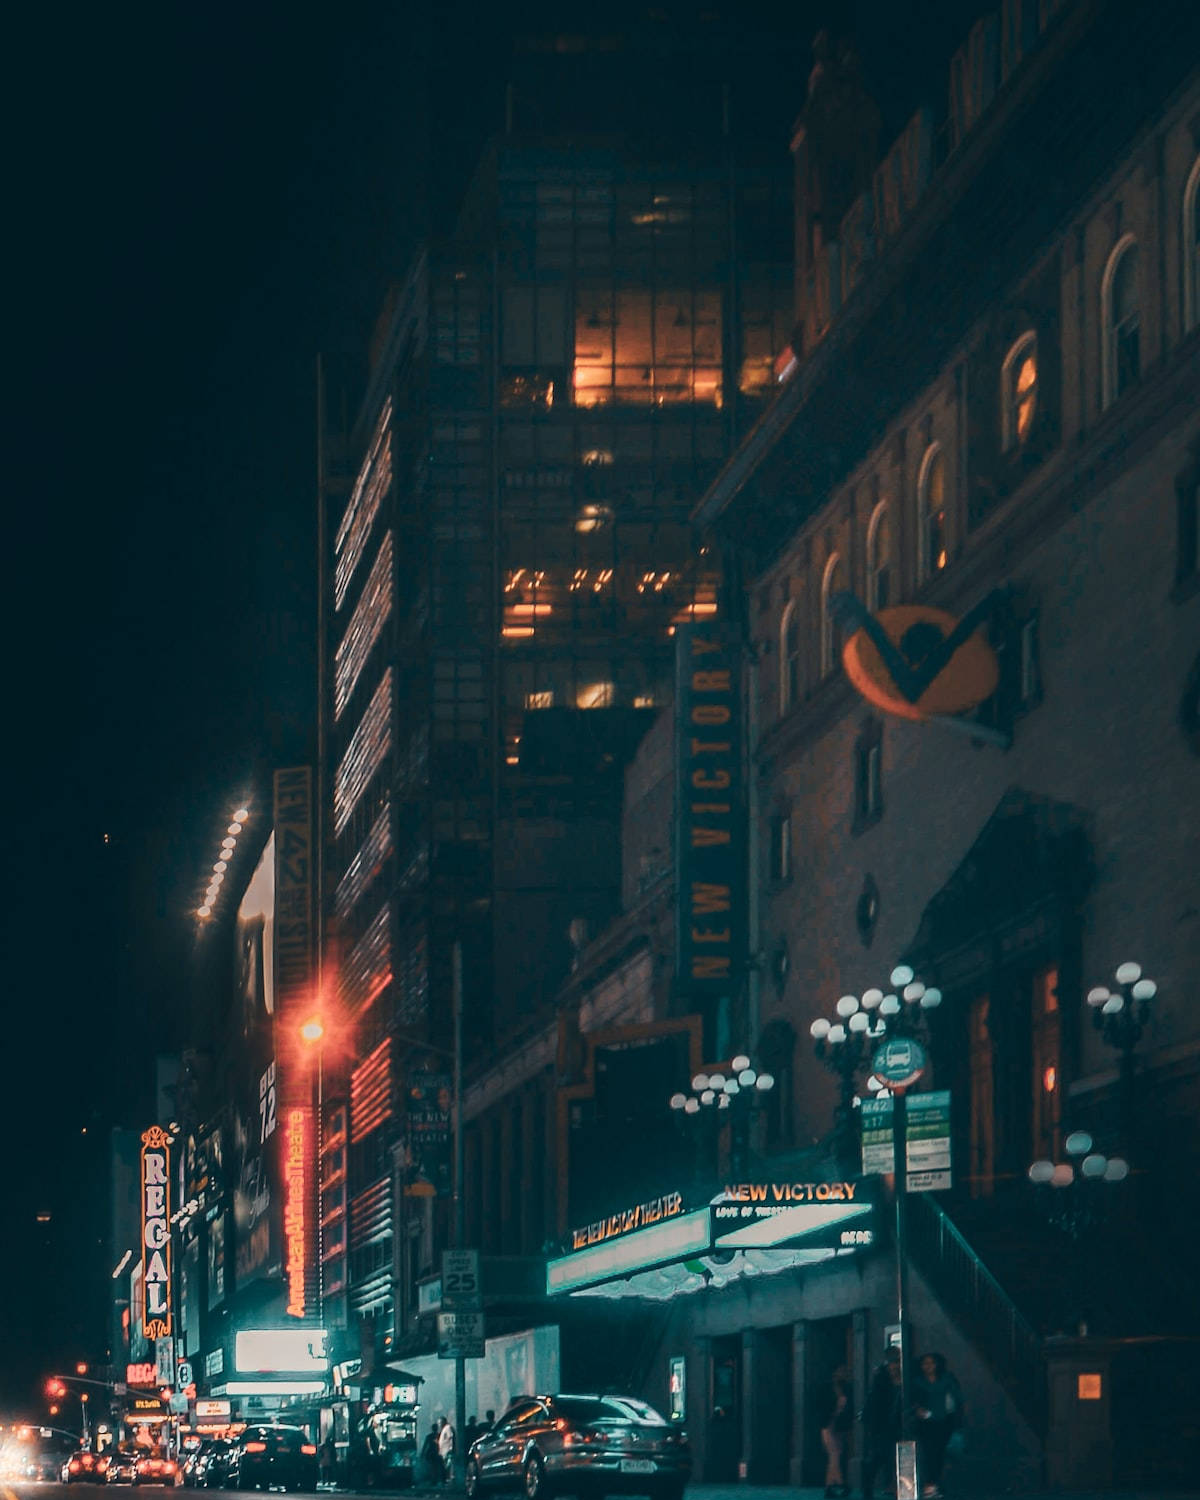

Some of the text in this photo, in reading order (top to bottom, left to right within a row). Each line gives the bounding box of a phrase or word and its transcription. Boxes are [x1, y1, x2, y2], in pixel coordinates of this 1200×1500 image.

[691, 634, 732, 980] NEW VICTORY
[862, 1102, 887, 1114] M42
[724, 1183, 856, 1201] NEW VICTORY
[144, 1153, 171, 1314] REGAL
[446, 1274, 476, 1291] 25
[127, 1363, 158, 1384] REGA
